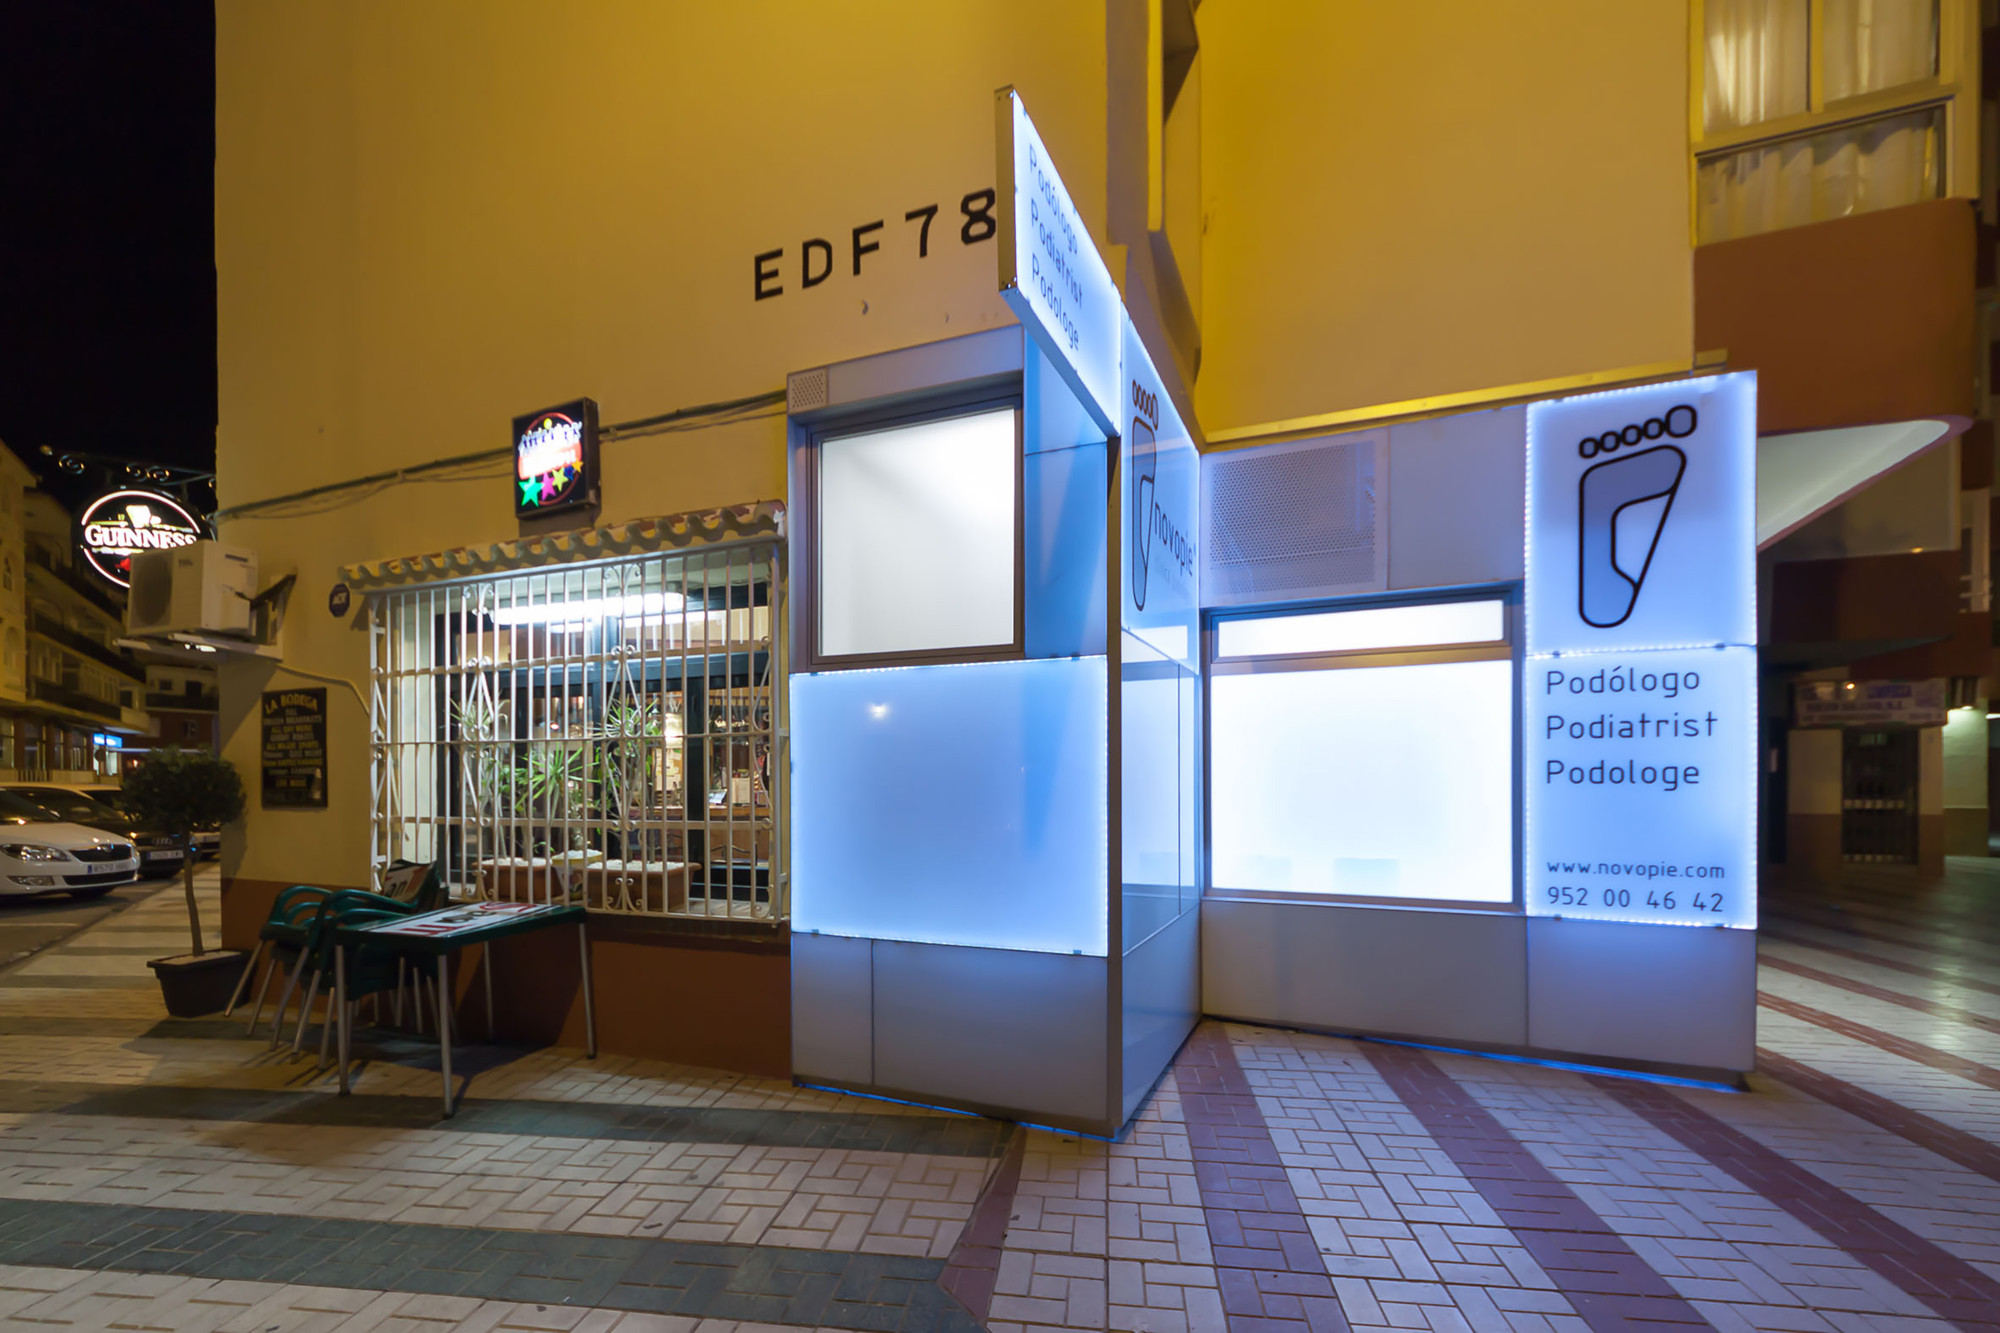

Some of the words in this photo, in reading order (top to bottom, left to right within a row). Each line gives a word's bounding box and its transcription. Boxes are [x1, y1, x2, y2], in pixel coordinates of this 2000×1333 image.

[1029, 143, 1077, 255] Podólogo
[1031, 198, 1082, 308] Podiatrist
[1032, 253, 1079, 351] Podologe
[1154, 501, 1193, 577] novopie
[1546, 665, 1700, 698] Podólogo
[1546, 711, 1718, 739] Podiatrist
[1546, 759, 1700, 791] Podologe
[1547, 861, 1725, 880] www.novopie.com
[1548, 886, 1588, 906] 952
[1603, 888, 1630, 908] 00
[1646, 890, 1676, 910] 46
[1692, 891, 1723, 912] 42
